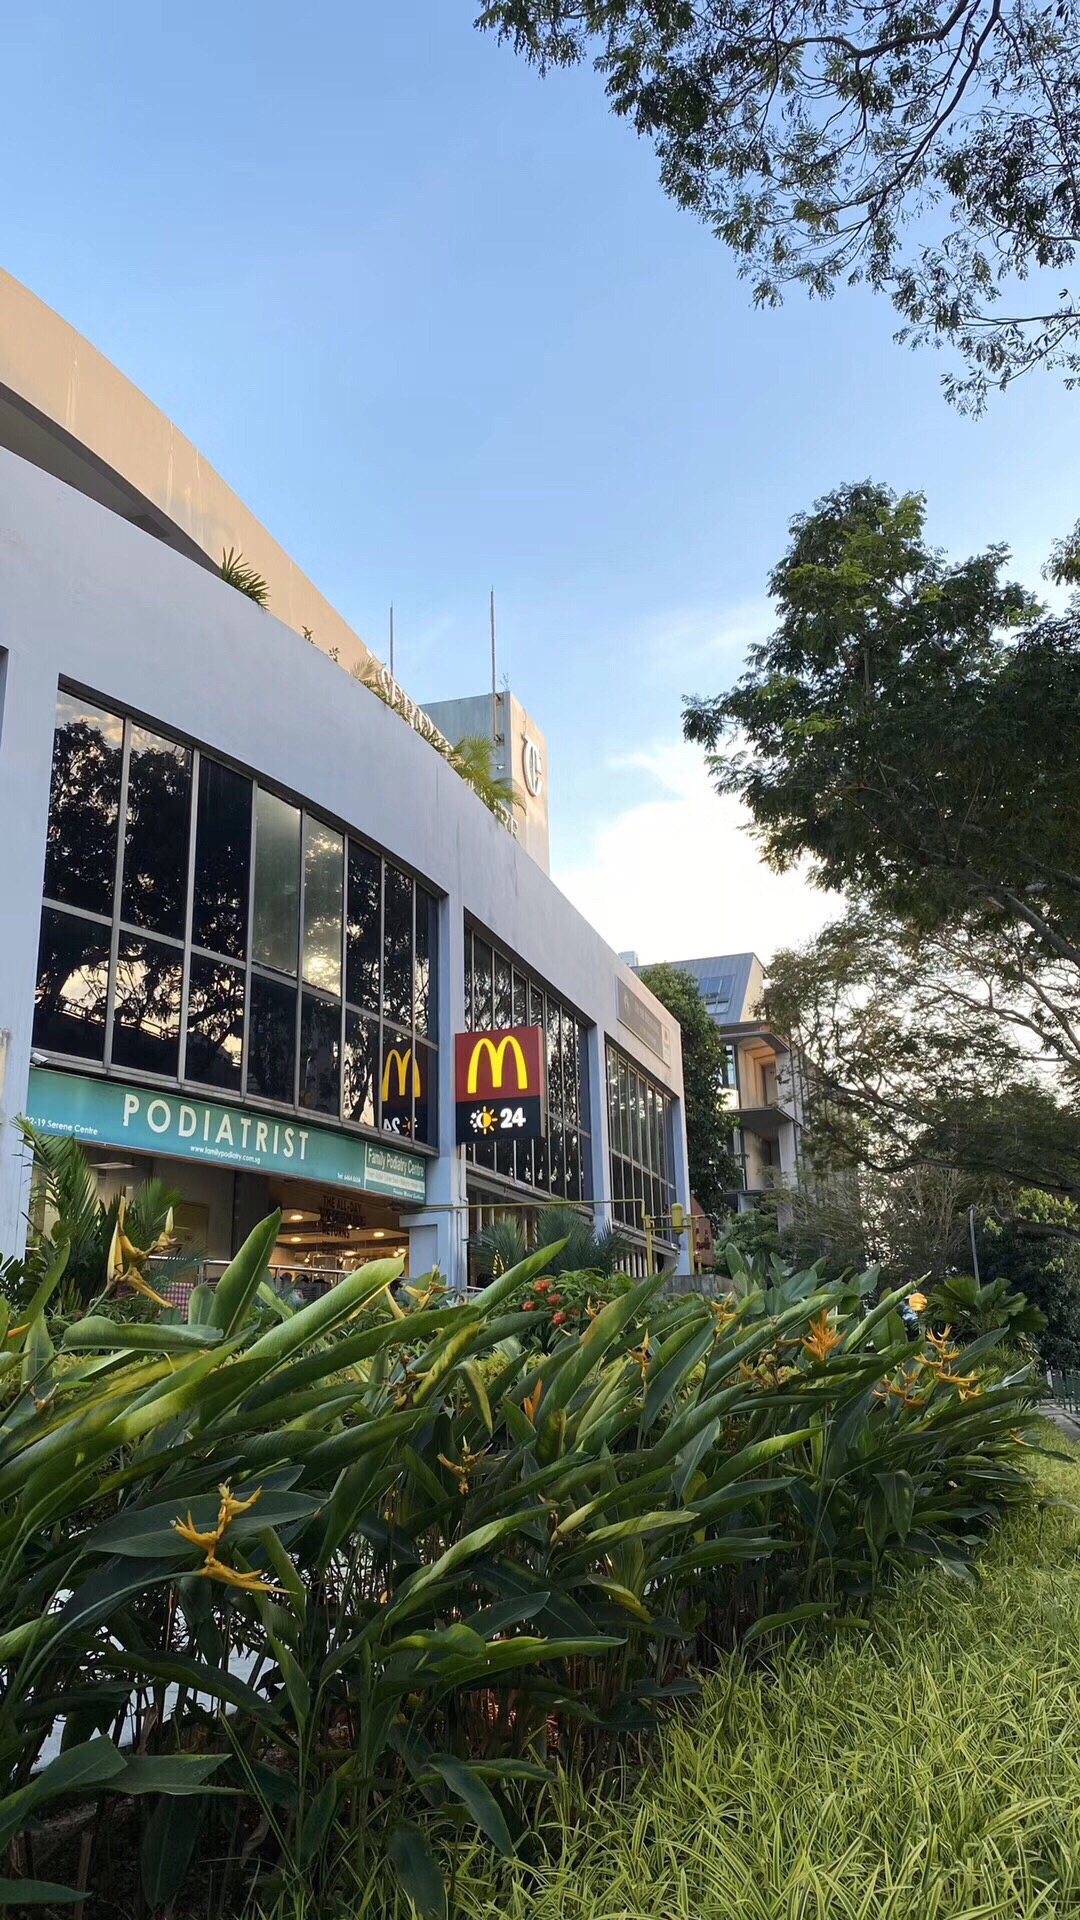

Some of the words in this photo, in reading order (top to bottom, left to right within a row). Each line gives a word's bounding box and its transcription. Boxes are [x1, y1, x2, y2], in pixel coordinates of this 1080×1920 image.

[47, 1120, 73, 1132] Serene
[74, 1124, 98, 1136] Centre
[122, 1093, 309, 1160] PODIATRIST
[500, 1106, 527, 1129] 24
[368, 1148, 386, 1170] Family
[387, 1153, 407, 1176] Podiatry
[408, 1159, 424, 1177] Centre
